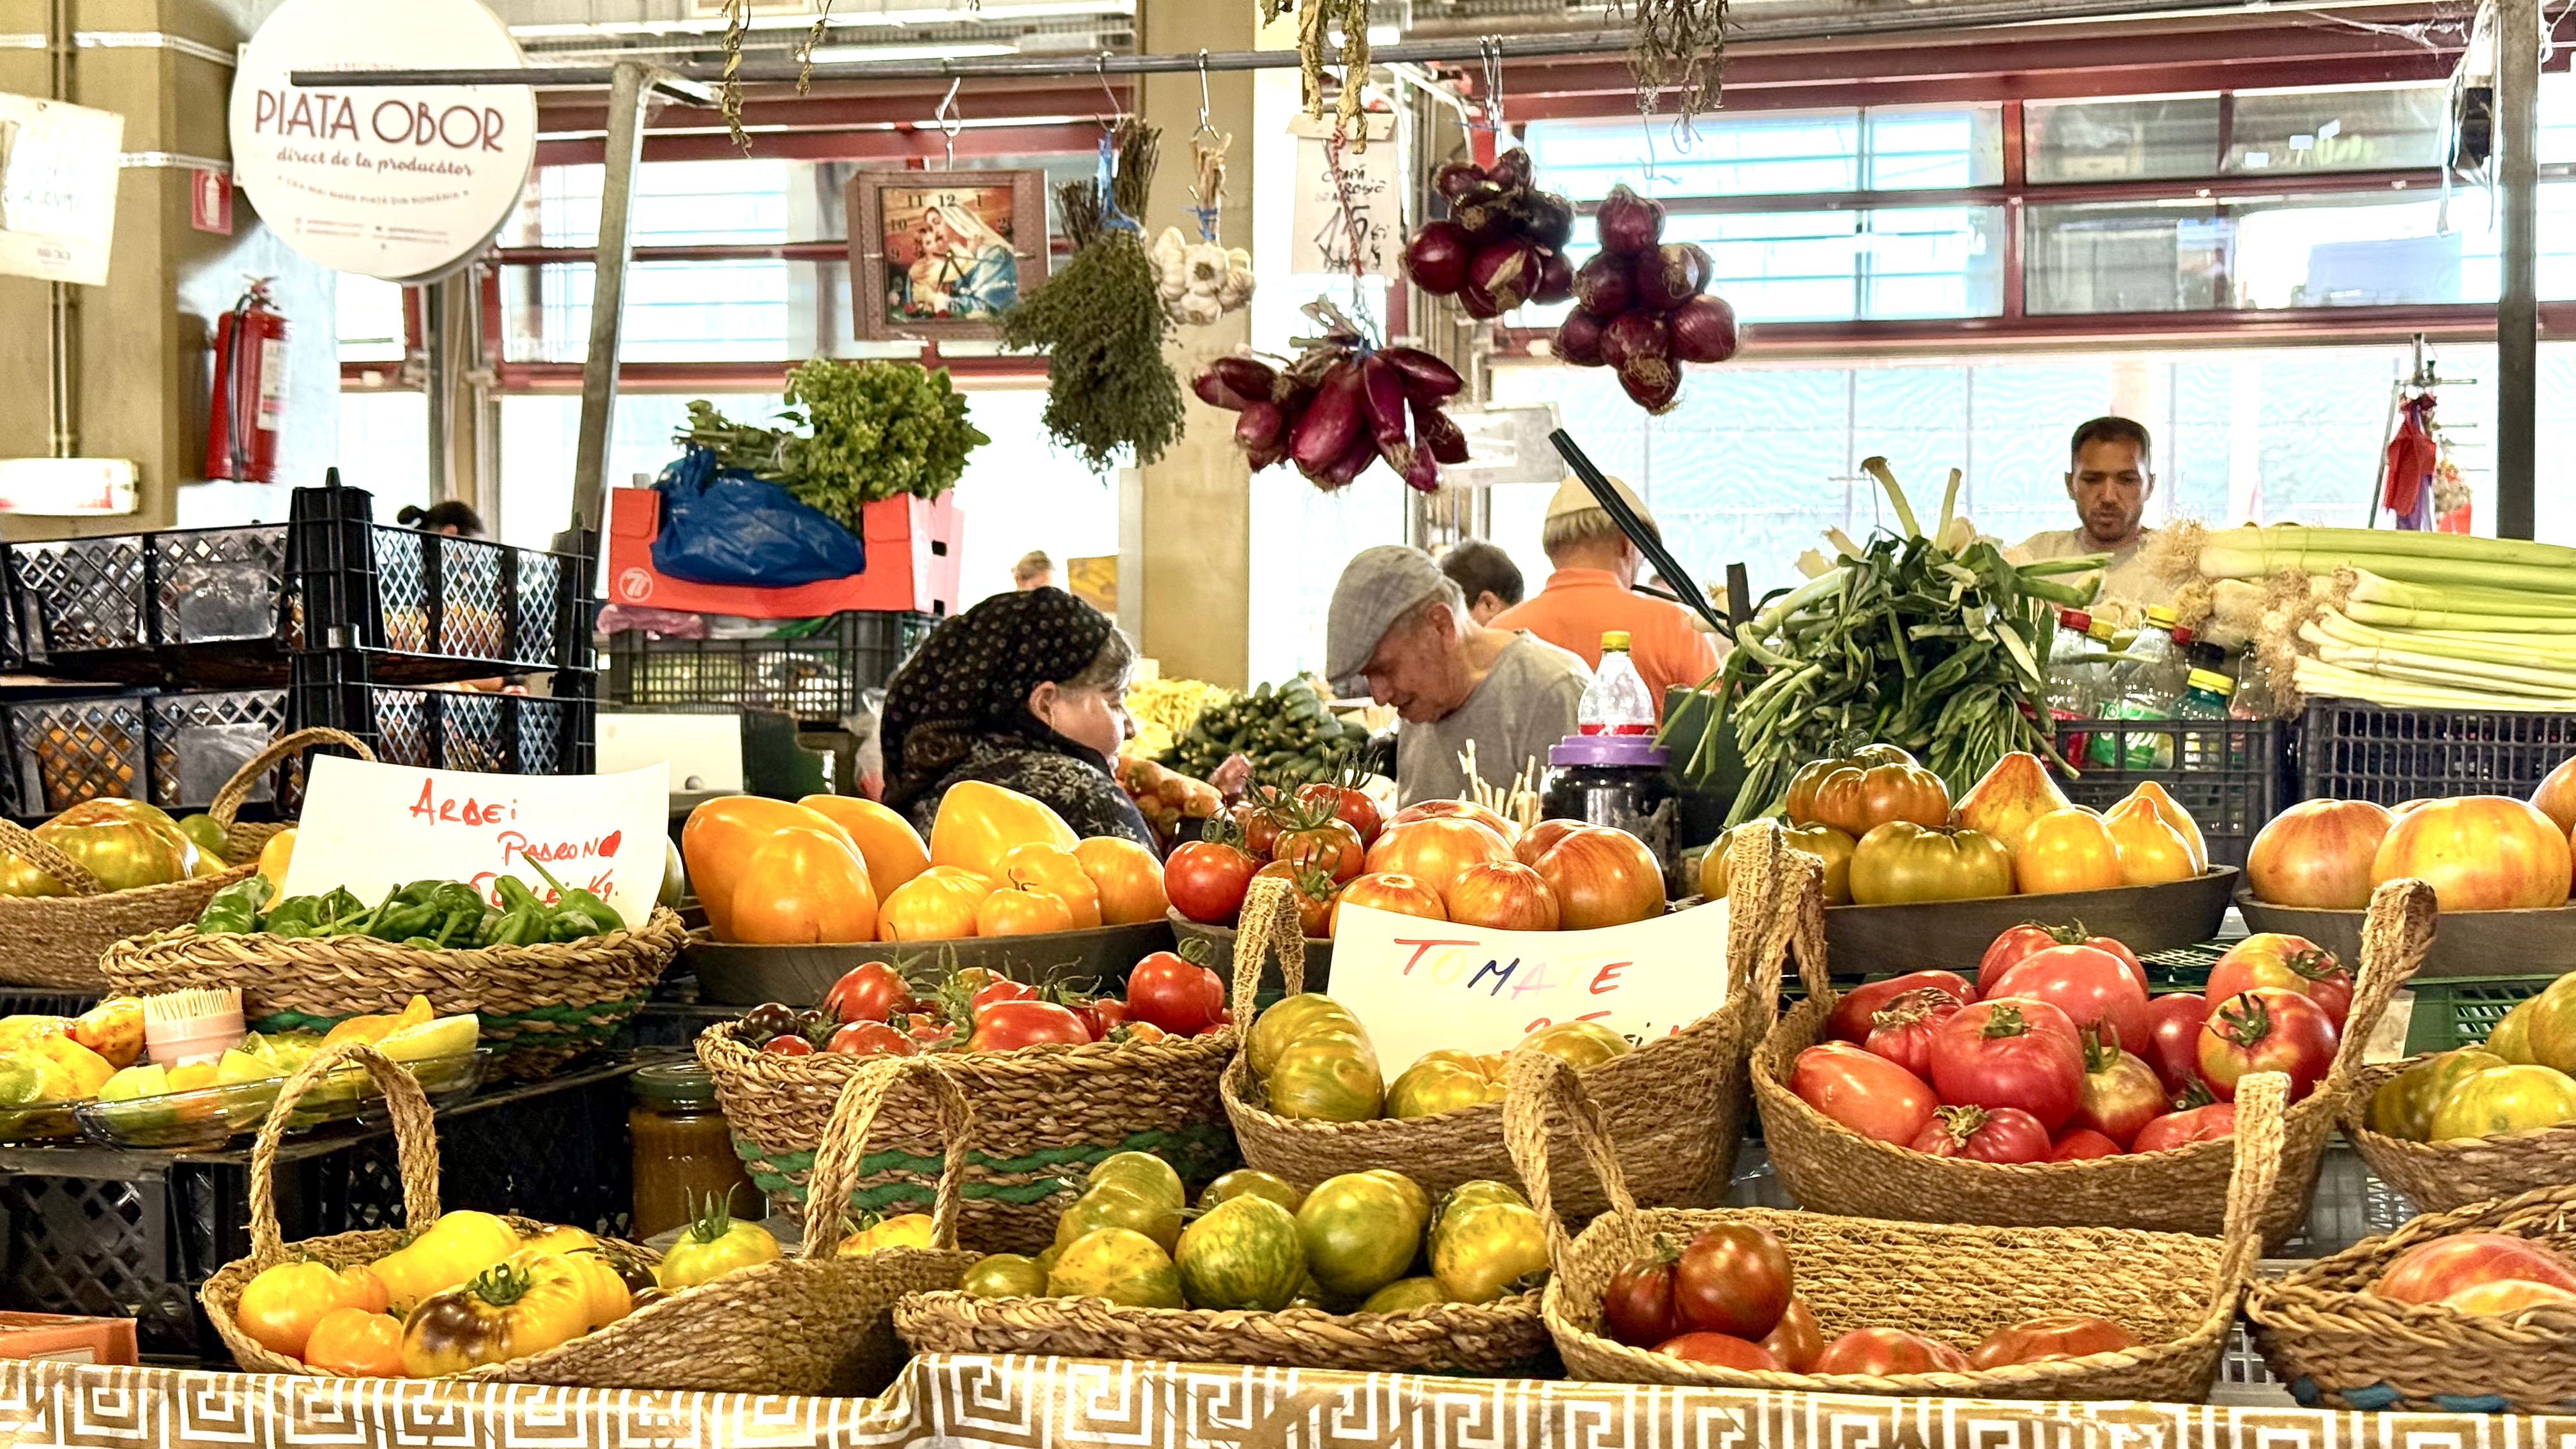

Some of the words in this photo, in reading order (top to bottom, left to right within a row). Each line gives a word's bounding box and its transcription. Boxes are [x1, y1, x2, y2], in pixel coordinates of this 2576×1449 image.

[372, 99, 504, 153] OBOR
[277, 146, 325, 164] direct
[330, 150, 351, 167] de
[356, 151, 372, 169] la
[908, 195, 923, 207] 11
[939, 194, 956, 207] 12
[976, 194, 982, 207] 1
[891, 218, 907, 231] 10
[1394, 939, 1633, 1000] TOMATE
